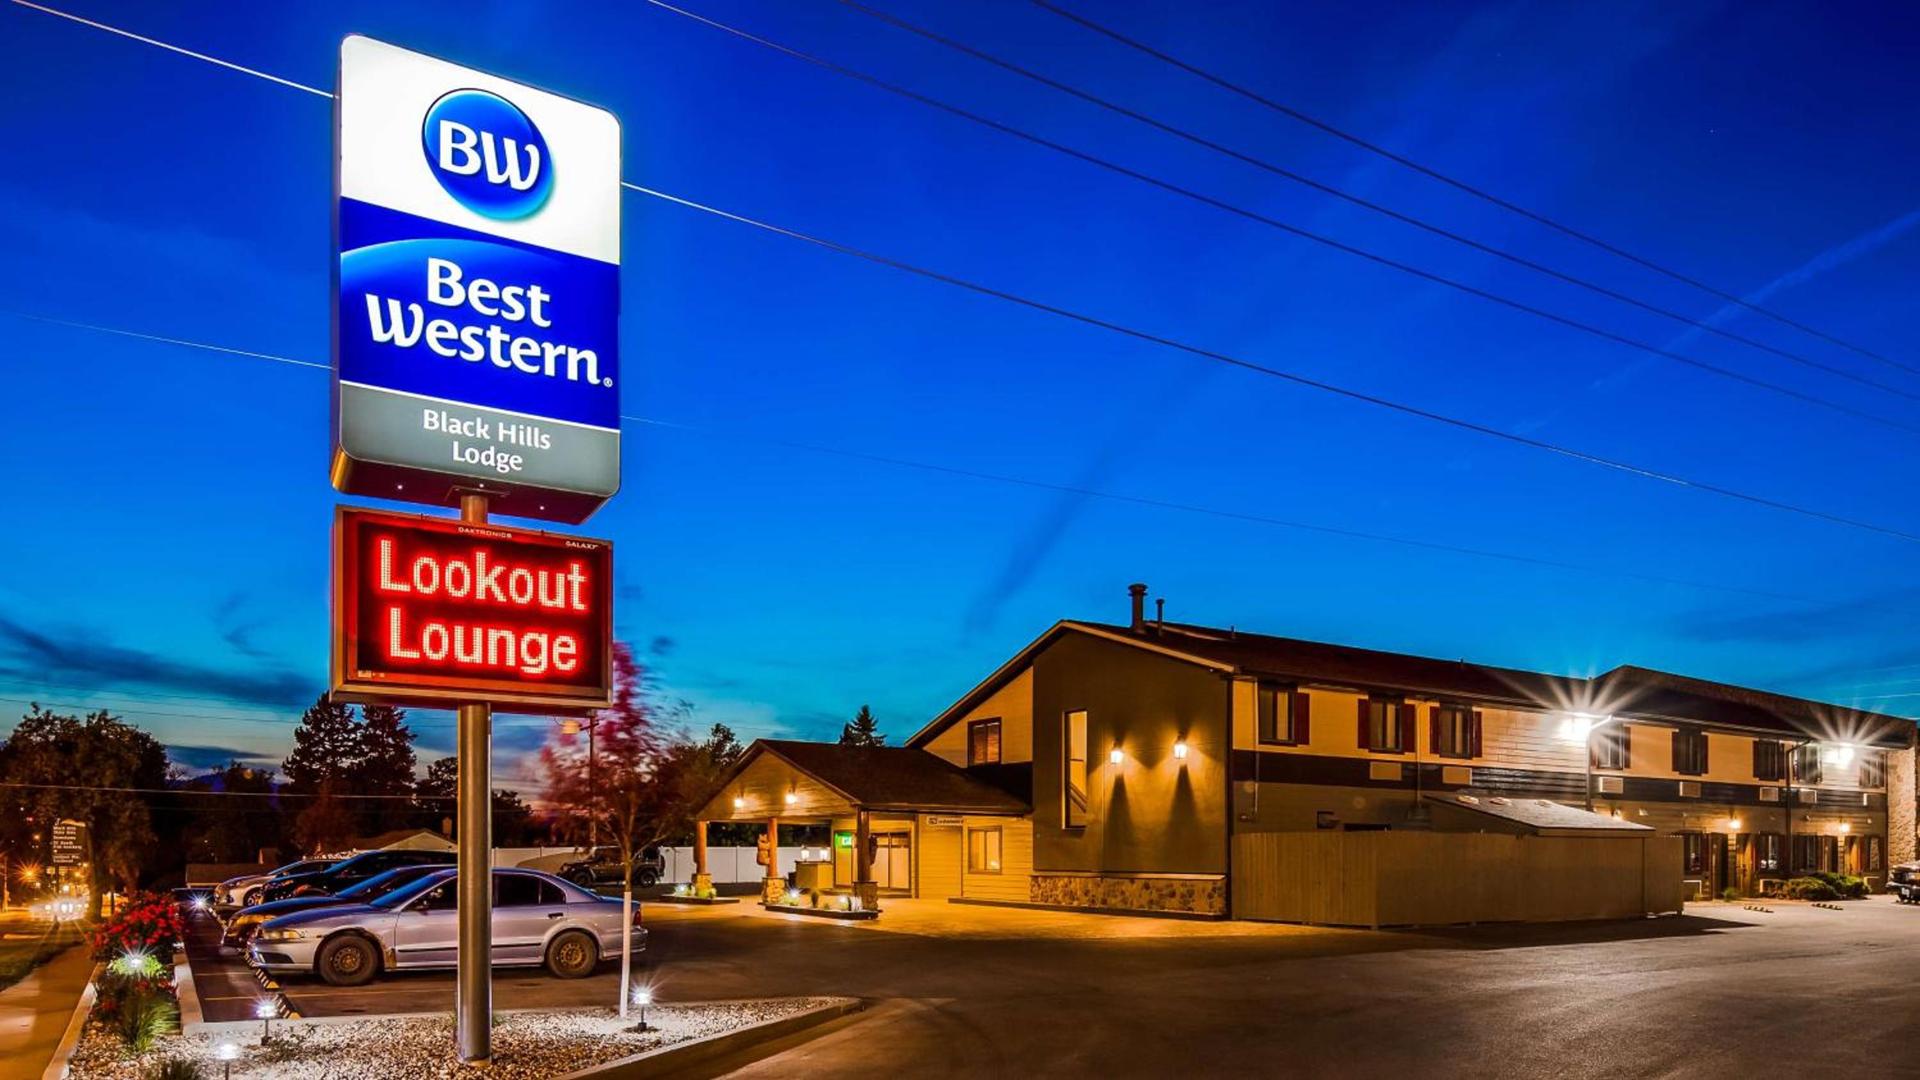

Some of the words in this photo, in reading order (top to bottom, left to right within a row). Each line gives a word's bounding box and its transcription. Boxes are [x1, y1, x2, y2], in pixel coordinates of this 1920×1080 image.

[439, 119, 541, 191] BW
[427, 257, 552, 328] Best
[423, 408, 491, 440] Black
[498, 422, 551, 450] Hills
[452, 440, 523, 473] Lodge
[380, 539, 588, 611] Lookout
[390, 607, 577, 675] Lounge
